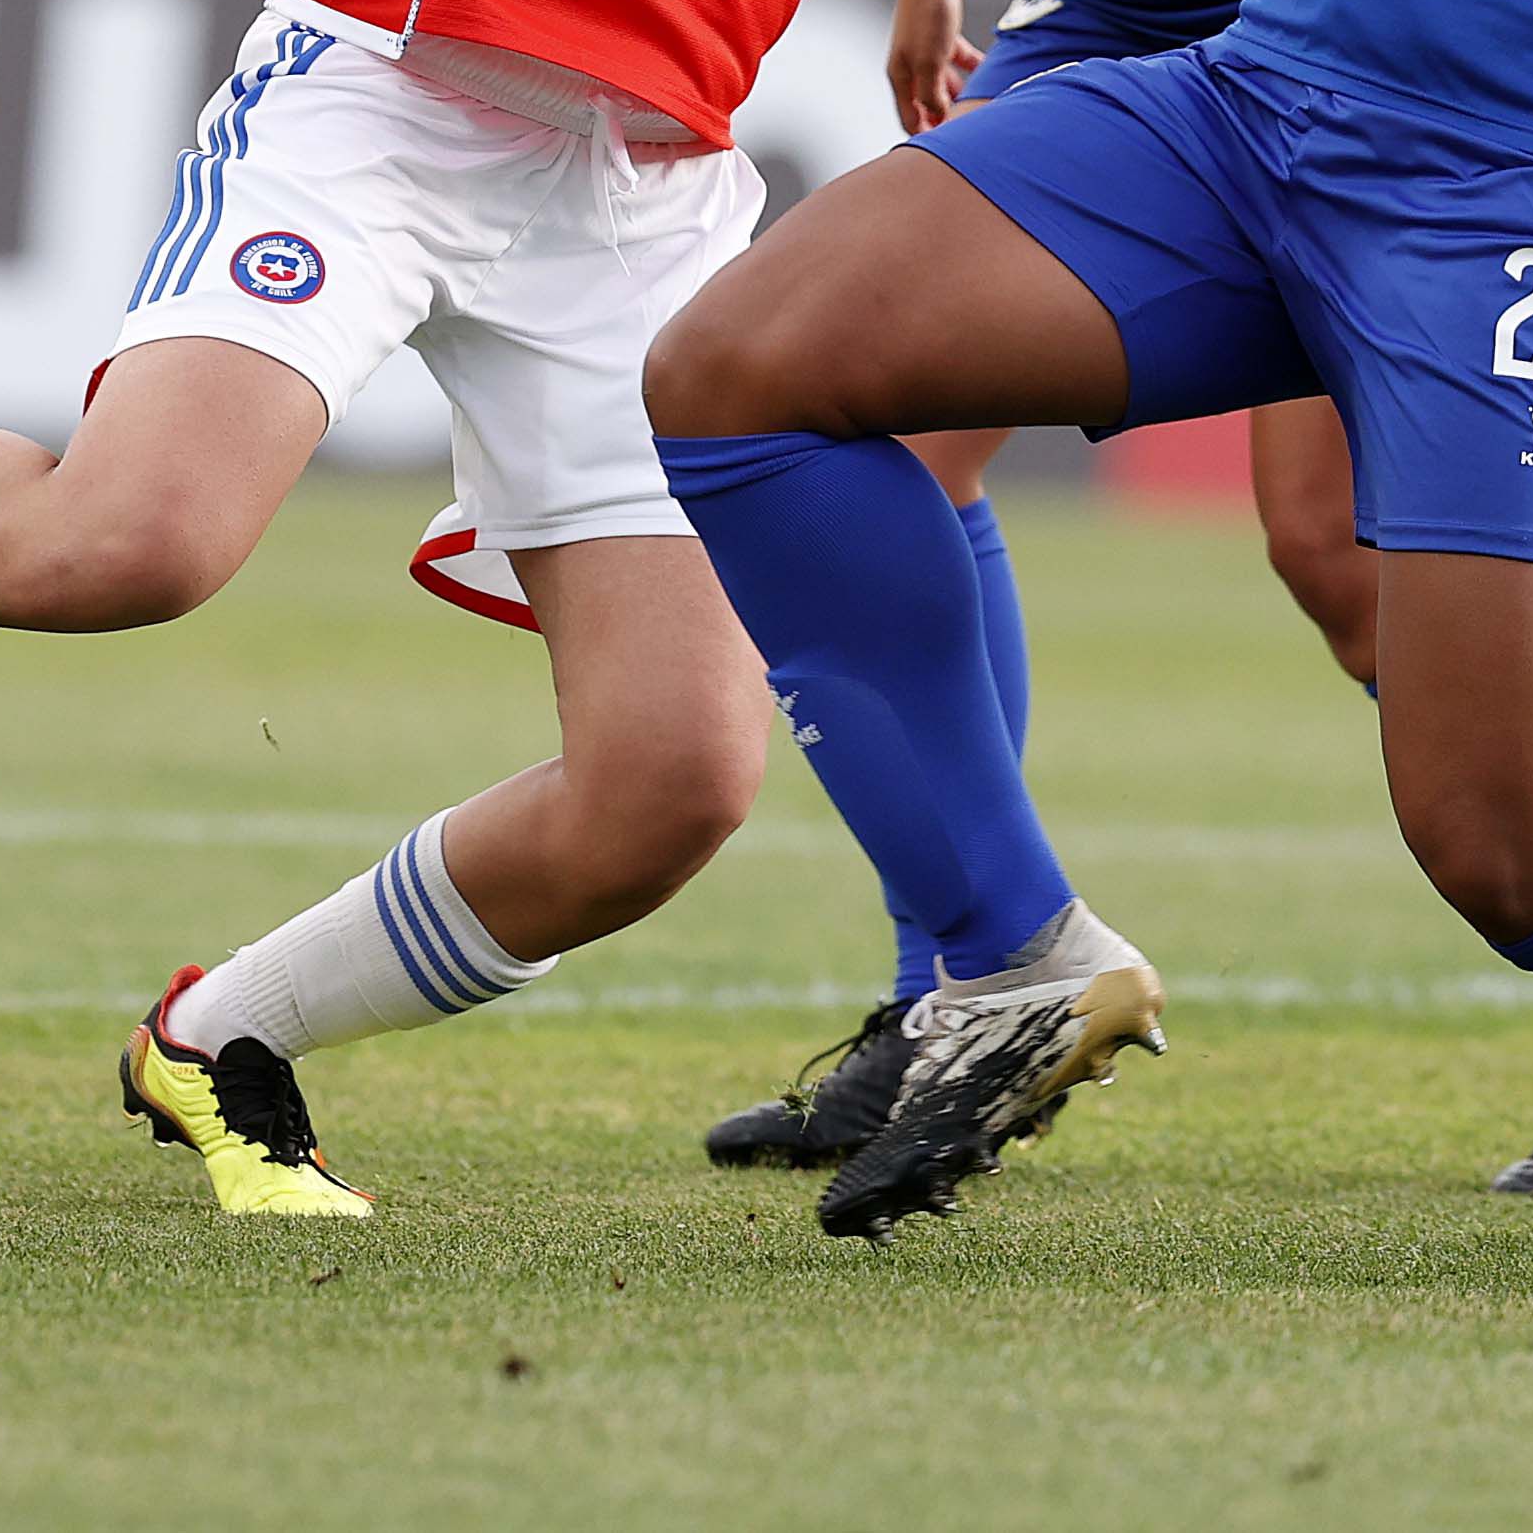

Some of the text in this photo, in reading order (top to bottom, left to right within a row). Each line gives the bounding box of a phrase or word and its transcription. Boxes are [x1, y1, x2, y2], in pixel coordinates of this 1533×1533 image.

[290, 242, 303, 253] DE
[251, 281, 294, 297] DE CHILE
[170, 1065, 195, 1076] COPA
